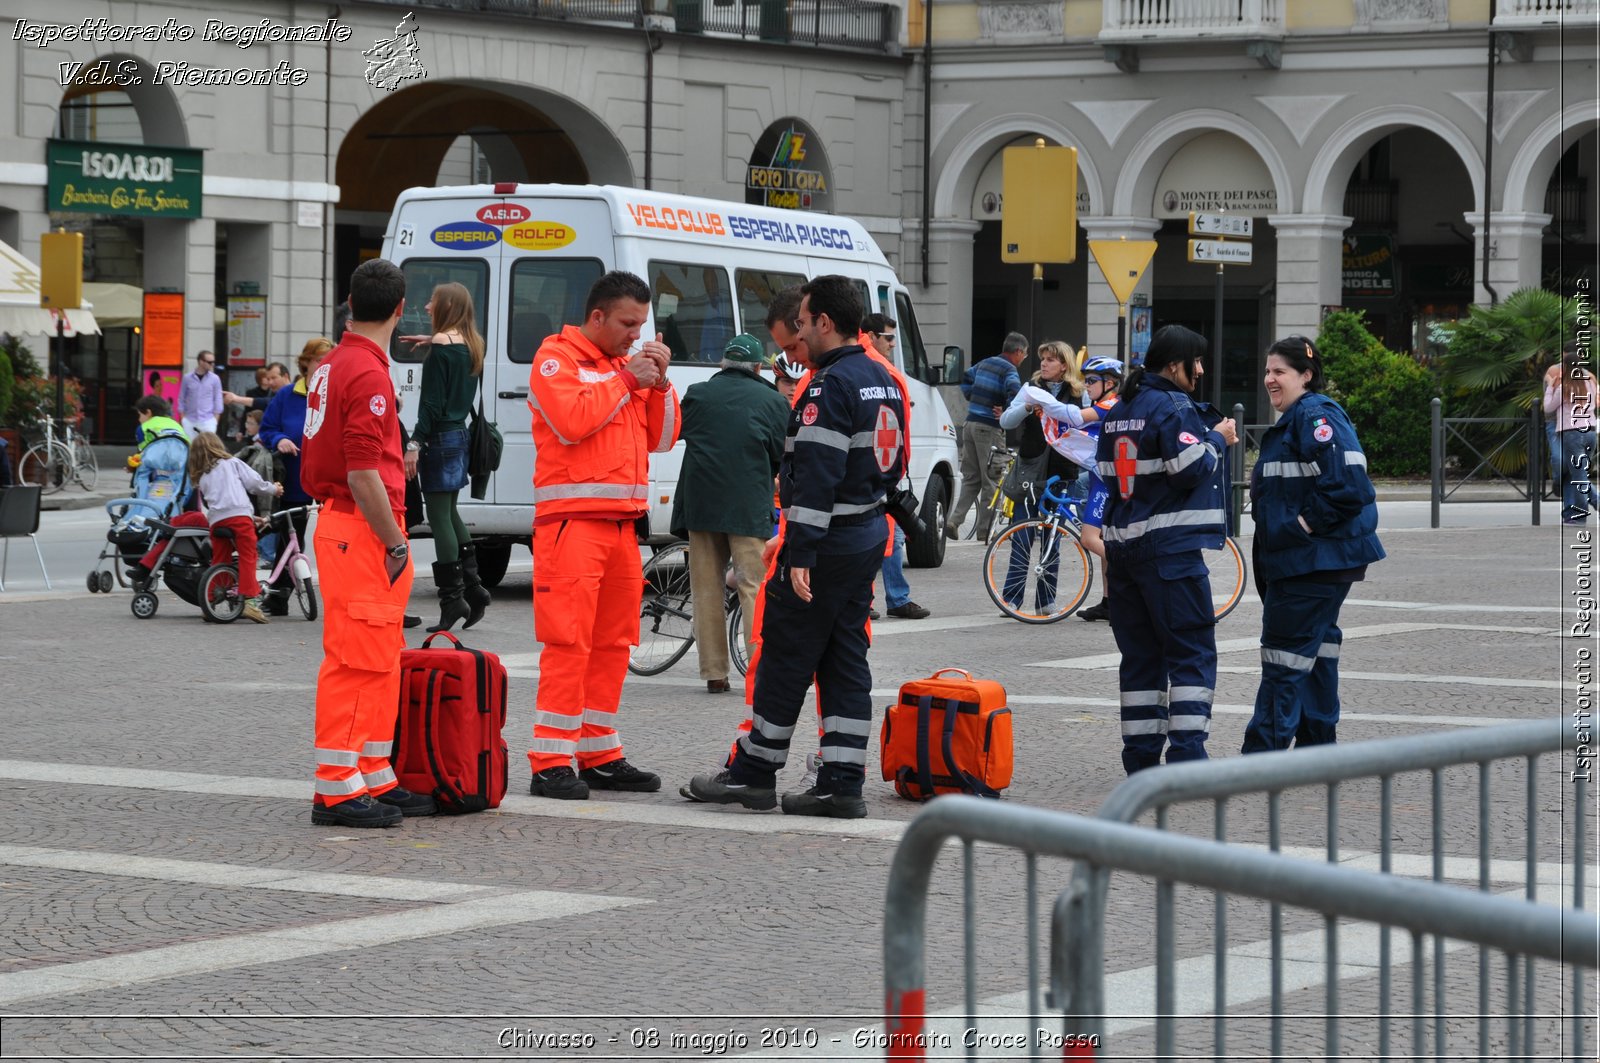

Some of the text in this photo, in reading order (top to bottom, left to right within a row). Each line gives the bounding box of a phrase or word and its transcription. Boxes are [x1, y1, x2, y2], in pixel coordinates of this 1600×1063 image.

[81, 150, 174, 182] ISOARDI
[751, 169, 783, 188] FOTO
[1180, 190, 1221, 201] MONTE
[1224, 190, 1243, 200] DEI
[1180, 201, 1192, 211] DI
[1196, 201, 1230, 211] SIENA
[482, 208, 524, 220] A.S.D.
[627, 203, 678, 231] VELO
[677, 208, 726, 235] CLUB
[727, 215, 799, 245] ESPERIA
[796, 223, 854, 251] PIASCO
[400, 229, 414, 246] 21
[435, 231, 497, 243] ESPERIA
[513, 228, 566, 239] ROLFO
